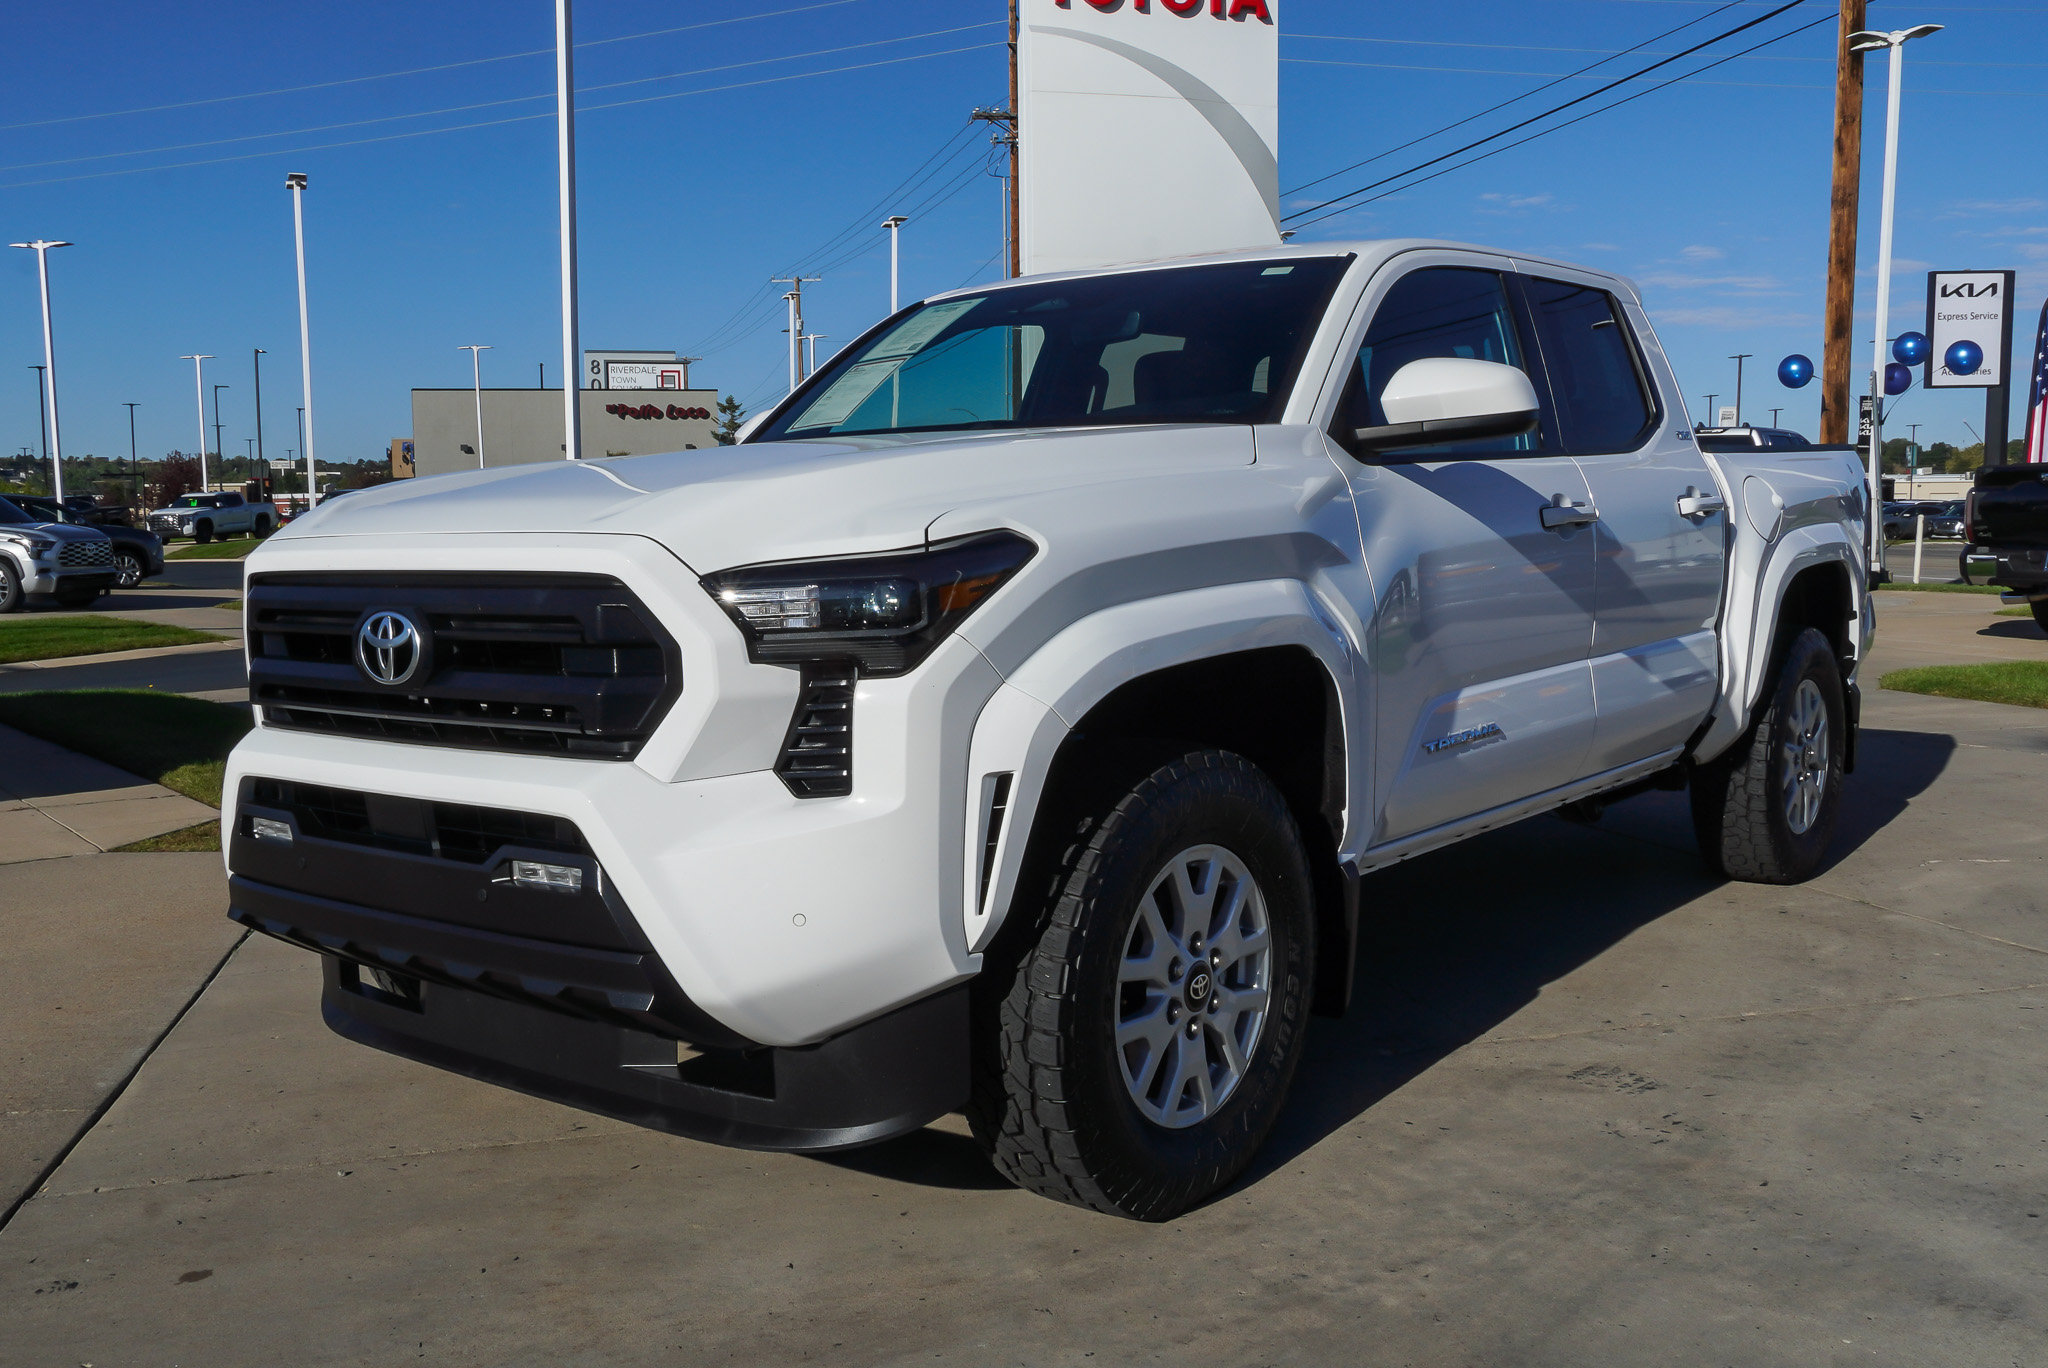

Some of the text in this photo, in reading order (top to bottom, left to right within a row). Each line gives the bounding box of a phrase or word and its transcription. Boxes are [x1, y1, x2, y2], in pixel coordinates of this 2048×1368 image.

[1937, 311, 1998, 322] Express Service
[610, 366, 657, 375] RIVERDALE
[611, 376, 637, 384] TOWN
[666, 404, 710, 420] Loco
